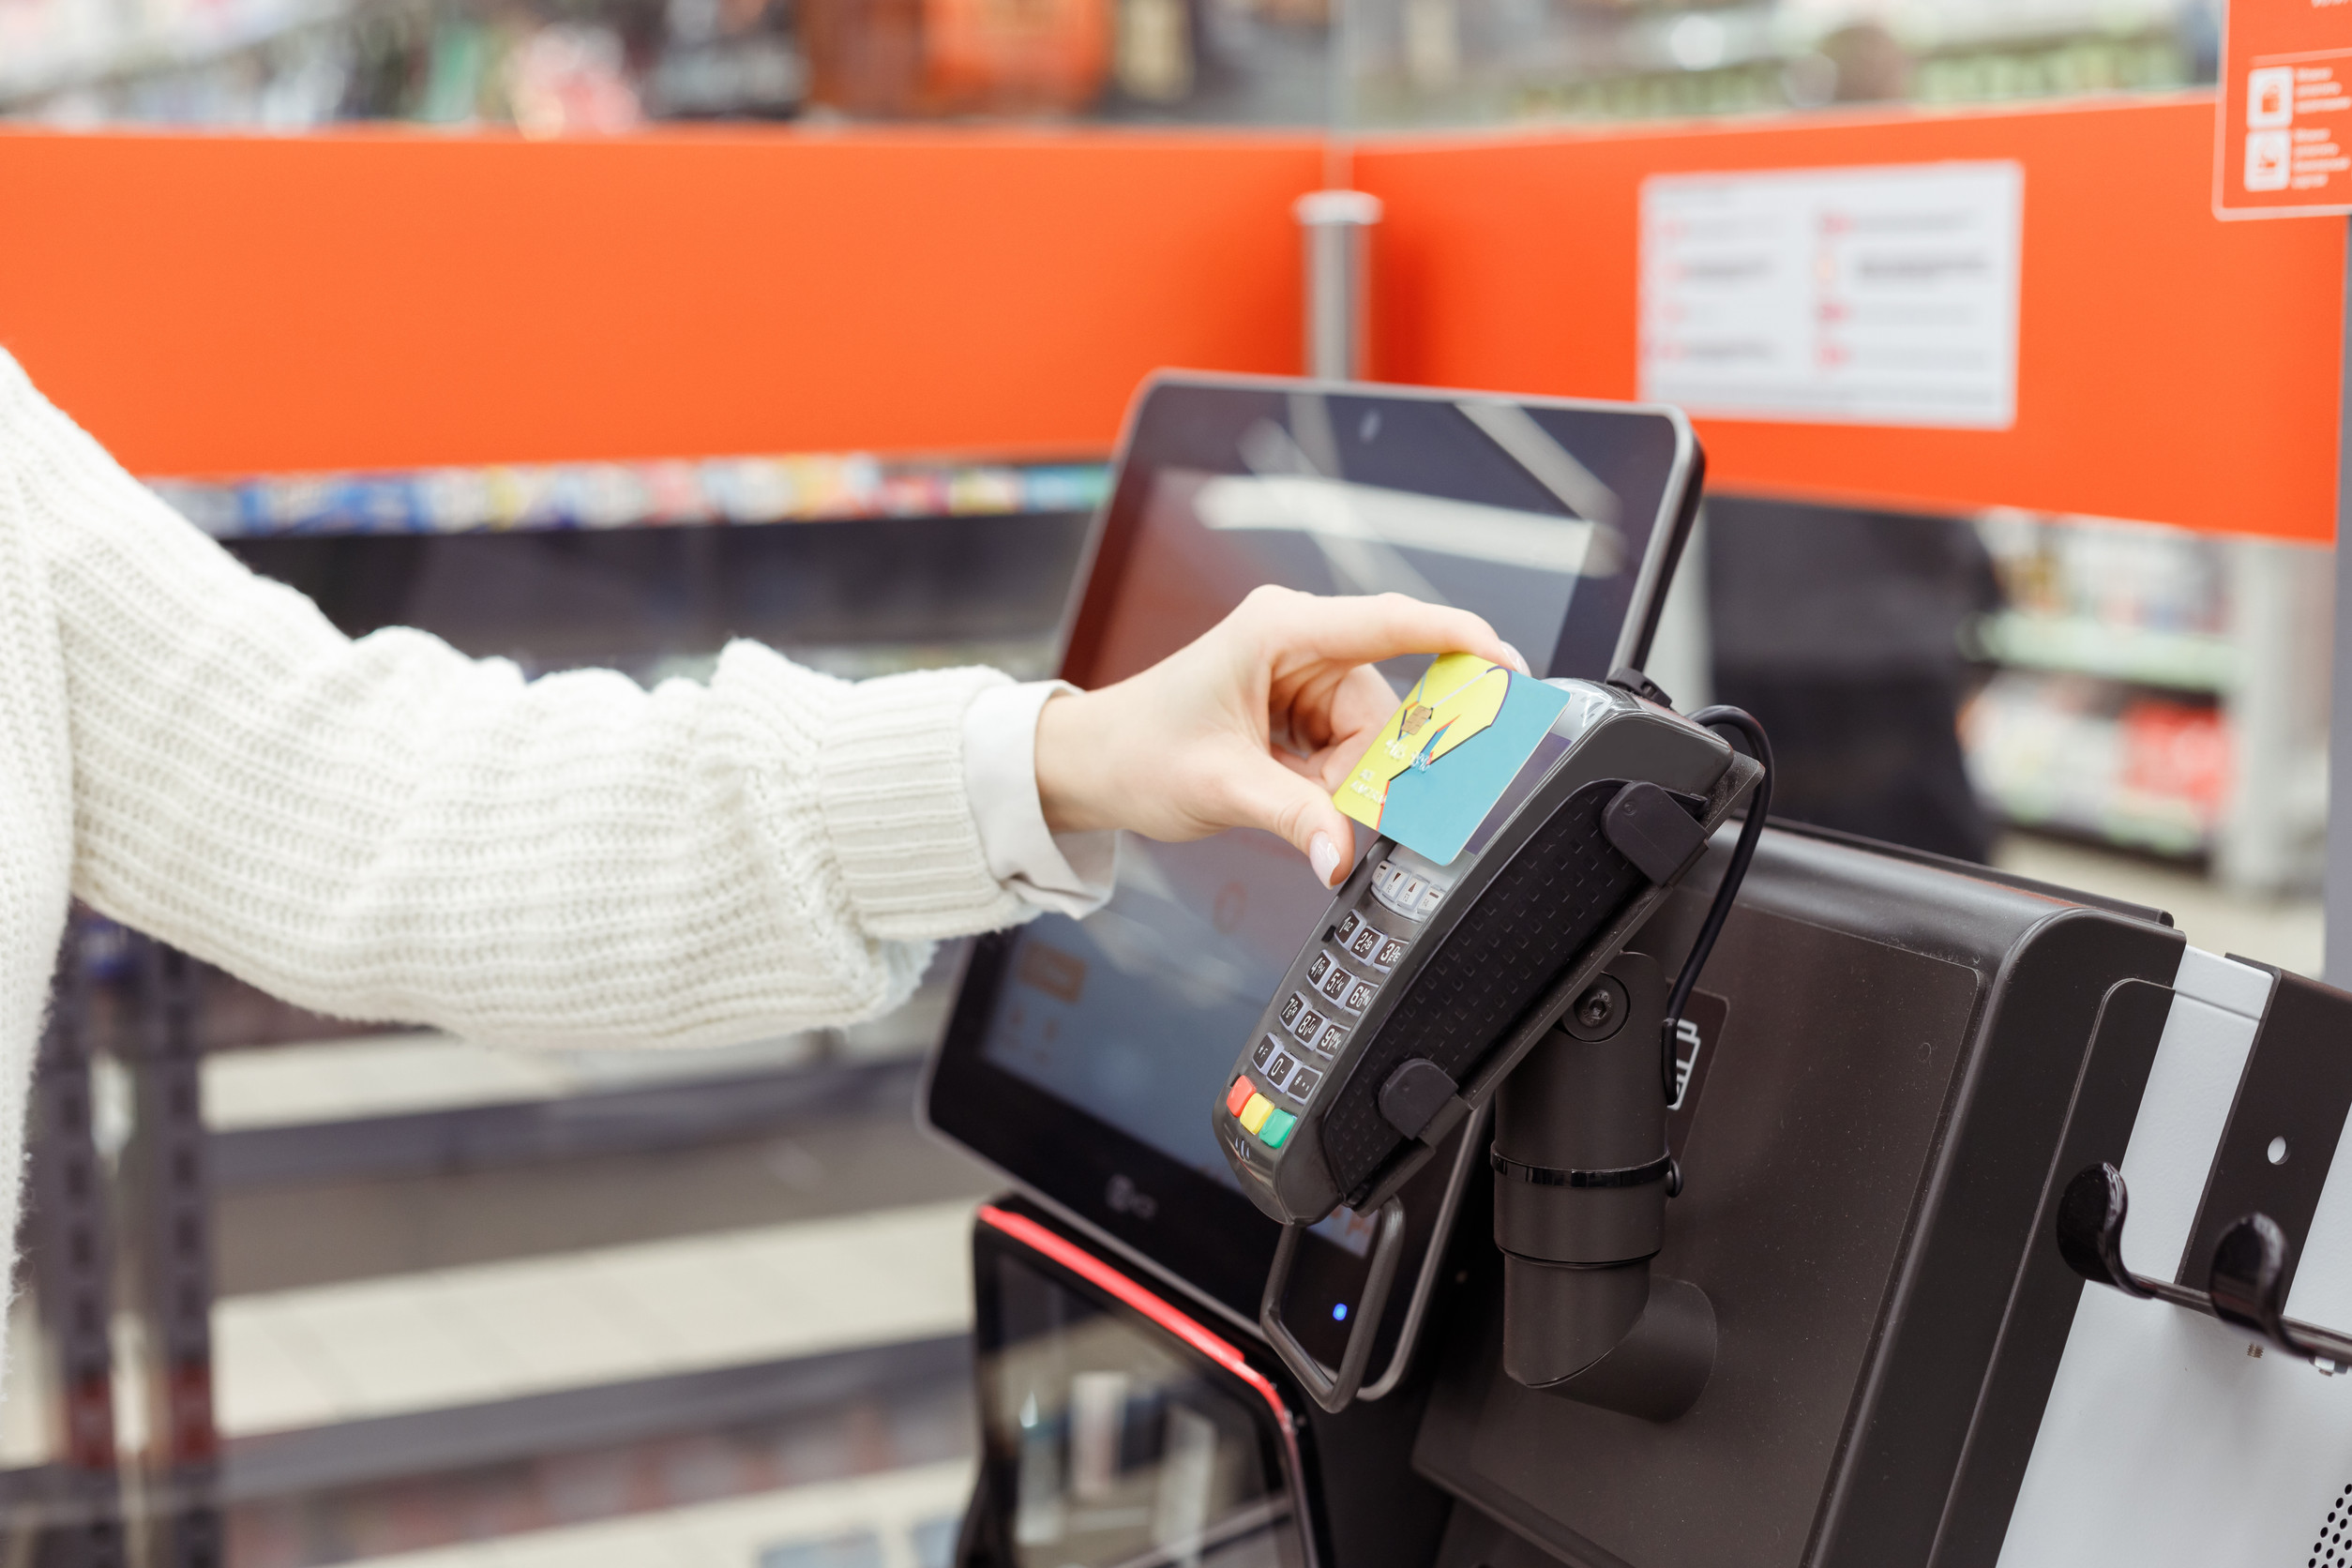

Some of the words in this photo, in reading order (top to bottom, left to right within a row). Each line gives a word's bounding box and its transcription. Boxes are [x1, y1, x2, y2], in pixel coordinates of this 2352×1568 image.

[1338, 915, 1351, 933] 1
[1354, 931, 1369, 951] 2
[1380, 942, 1395, 961] 3
[1311, 957, 1323, 975] 4
[1326, 972, 1340, 991] 5
[1349, 986, 1364, 1004] 6
[1282, 998, 1295, 1016] 7
[1298, 1015, 1312, 1033] 8
[1320, 1028, 1335, 1048] 9
[1271, 1058, 1284, 1077] 0
